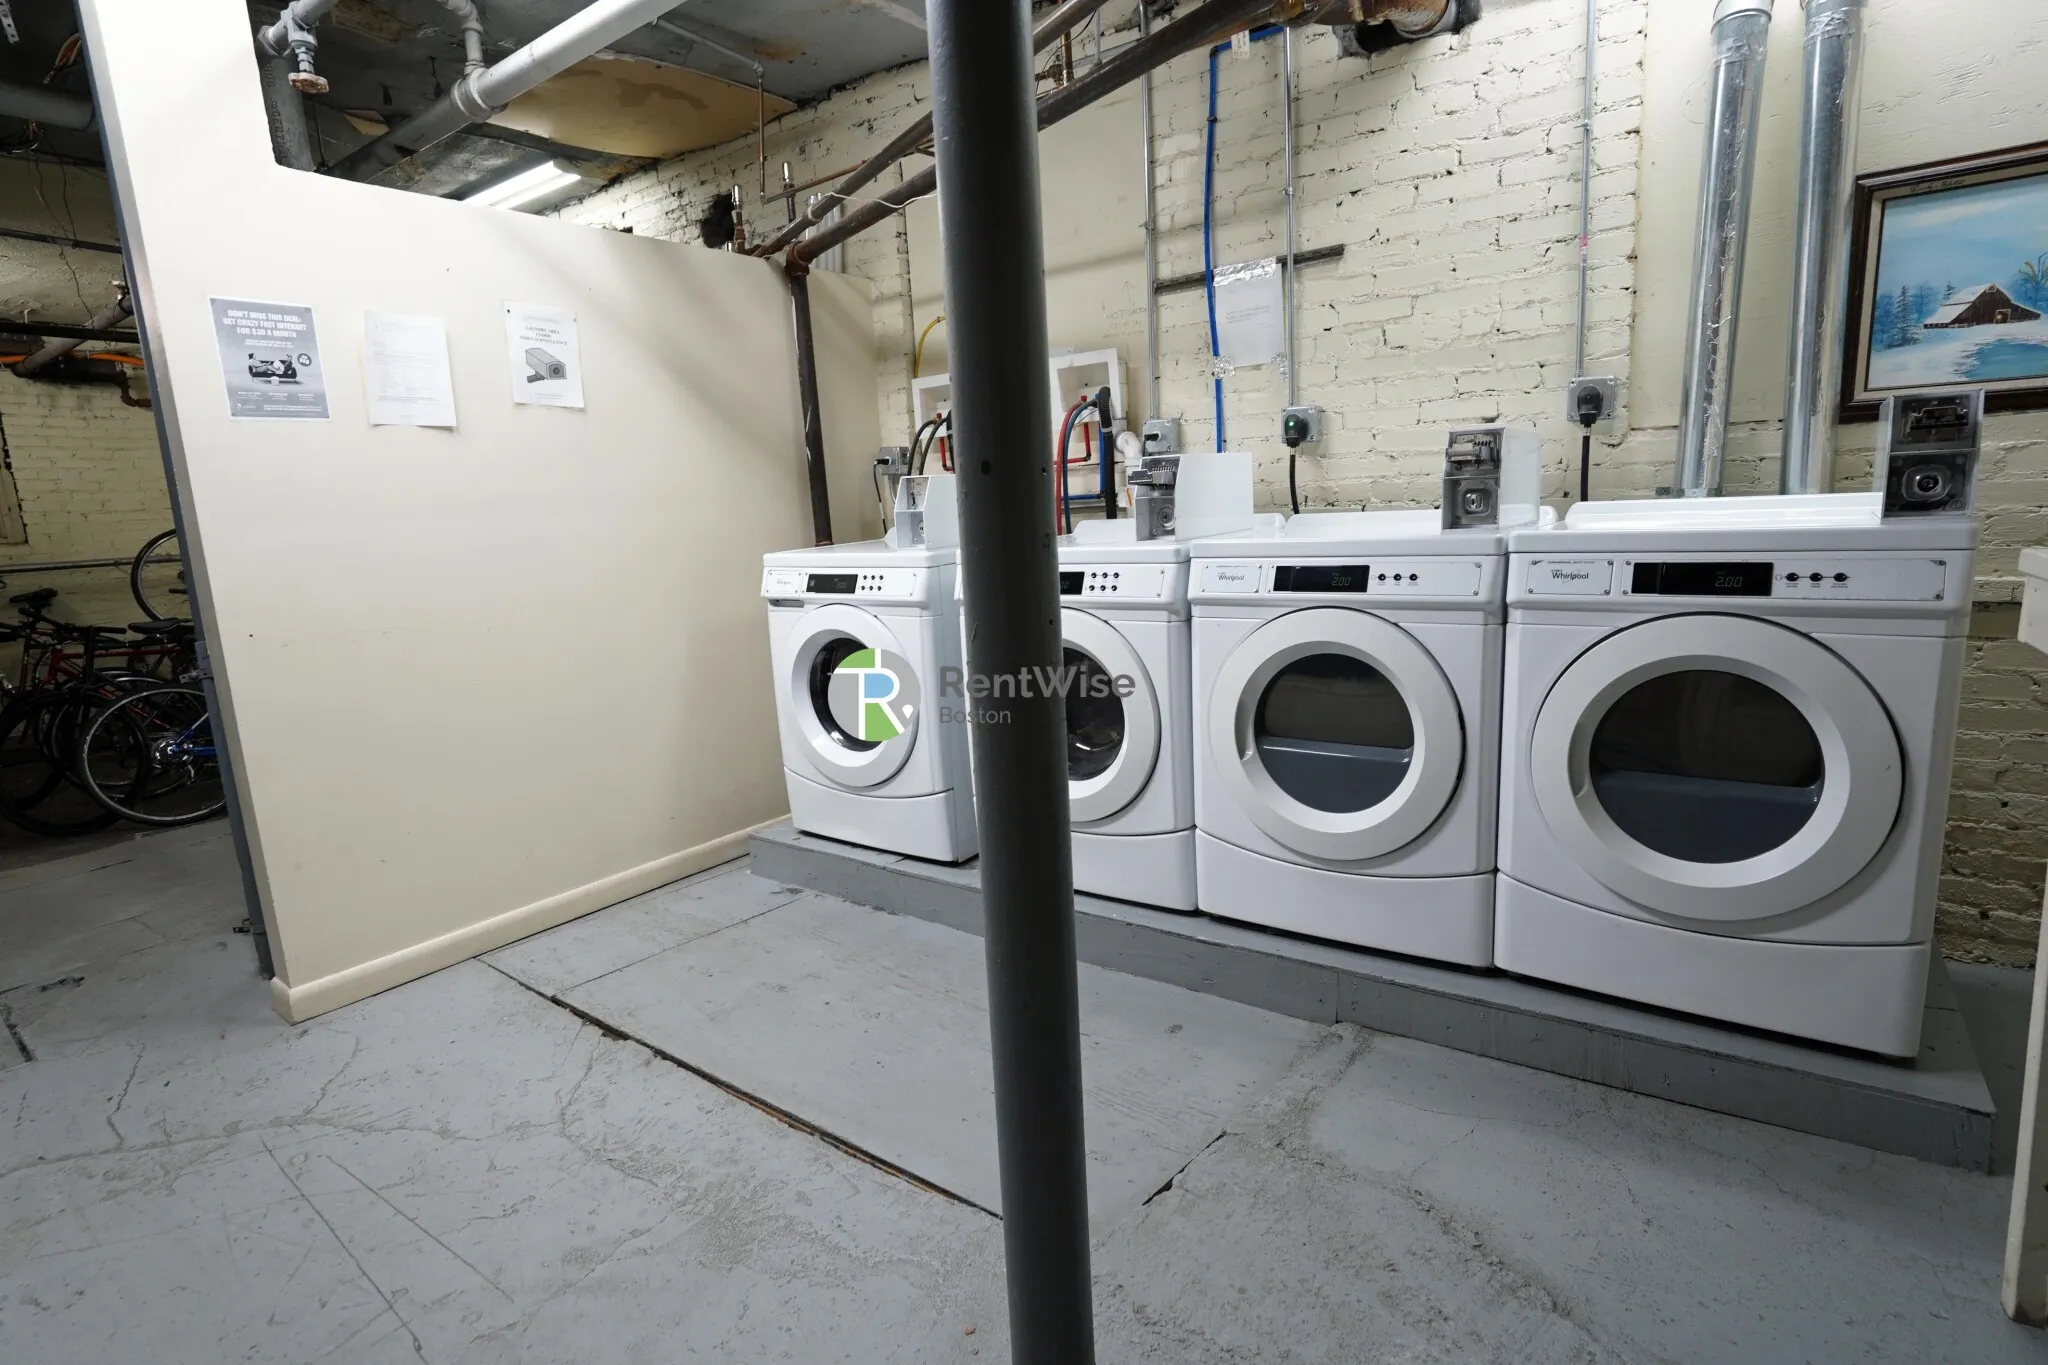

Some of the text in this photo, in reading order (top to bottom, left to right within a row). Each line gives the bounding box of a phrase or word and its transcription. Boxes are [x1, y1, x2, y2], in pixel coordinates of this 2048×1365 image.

[227, 309, 302, 323] DON'T MISS THIS DEAL:
[222, 317, 307, 331] GET CRAZY FAST INTERNET
[252, 328, 266, 336] $30
[273, 330, 297, 338] MONTH
[1551, 572, 1589, 580] Whirlpool
[1715, 576, 1743, 588] 2.00
